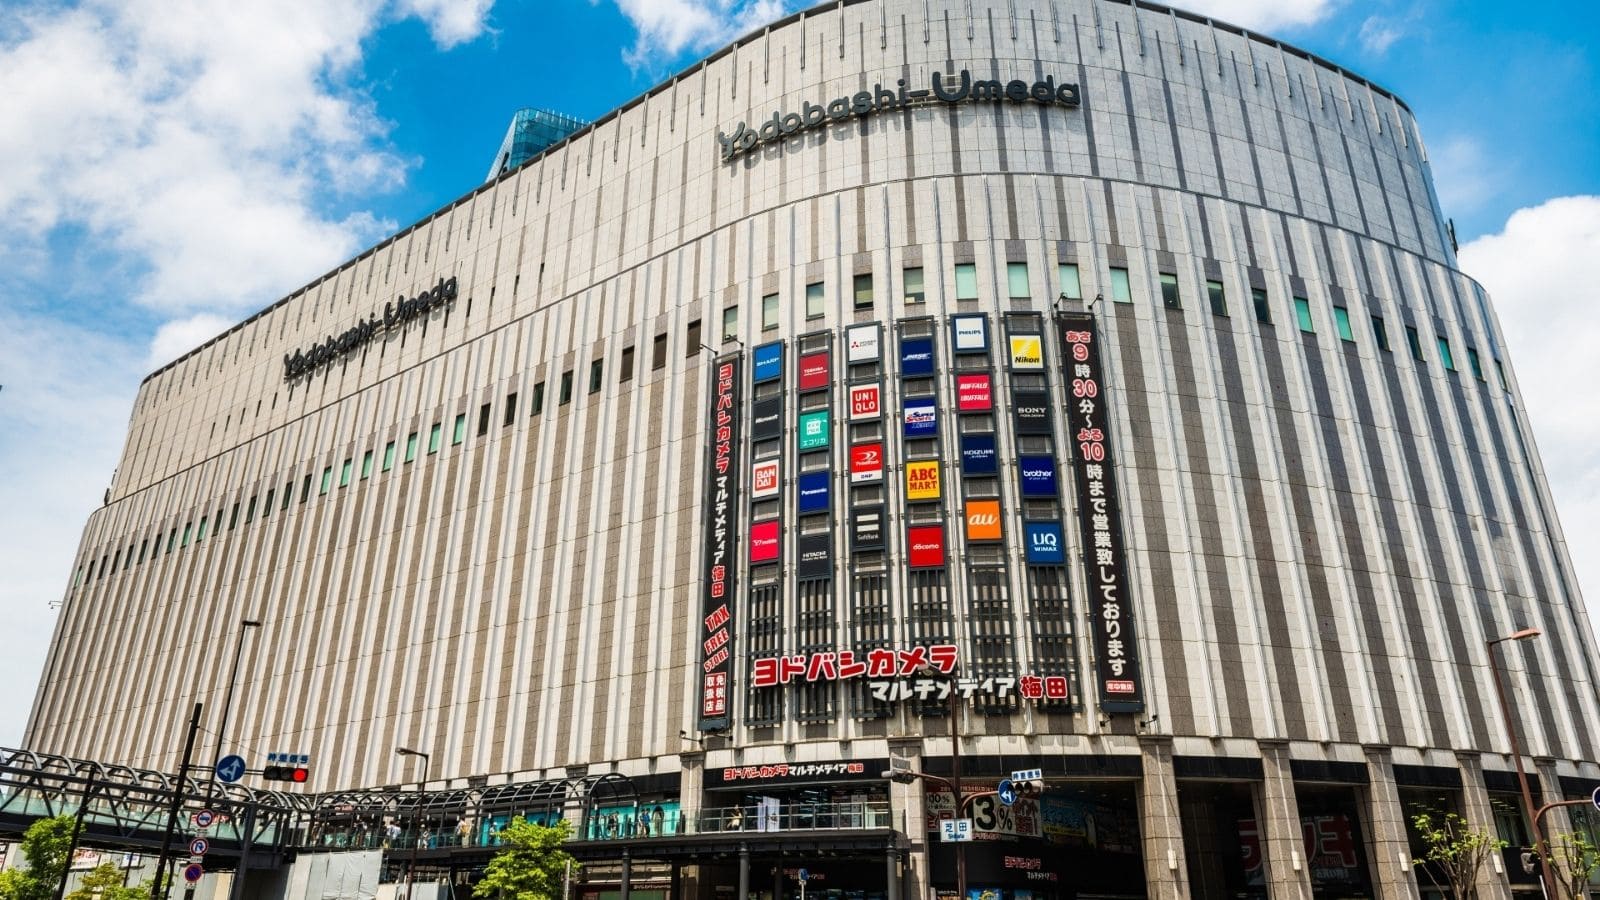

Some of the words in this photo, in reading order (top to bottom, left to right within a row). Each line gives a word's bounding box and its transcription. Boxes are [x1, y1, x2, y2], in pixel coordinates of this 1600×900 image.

[718, 69, 1081, 159] Yodobashi-Umeda
[284, 276, 456, 378] Yodobashi-Umeda
[756, 357, 780, 367] SHARP
[1014, 356, 1040, 364] Nikon
[855, 392, 874, 401] UNI
[855, 401, 876, 411] QLO
[802, 437, 826, 447] エコリカ
[756, 468, 776, 479] BAN
[909, 468, 937, 481] ABC
[1023, 469, 1052, 478] brother
[756, 478, 772, 489] DAI
[909, 481, 937, 490] MART
[801, 487, 827, 495] Panasonic
[968, 513, 998, 525] au
[1033, 533, 1057, 545] UQ
[913, 543, 939, 551] docomo
[802, 550, 827, 558] HITACHI
[705, 603, 730, 632] TAX
[704, 627, 729, 655] FREE
[704, 647, 729, 673] STORE
[753, 644, 959, 687] ヨドバシカメラ
[869, 675, 1068, 701] マルチメディア梅田
